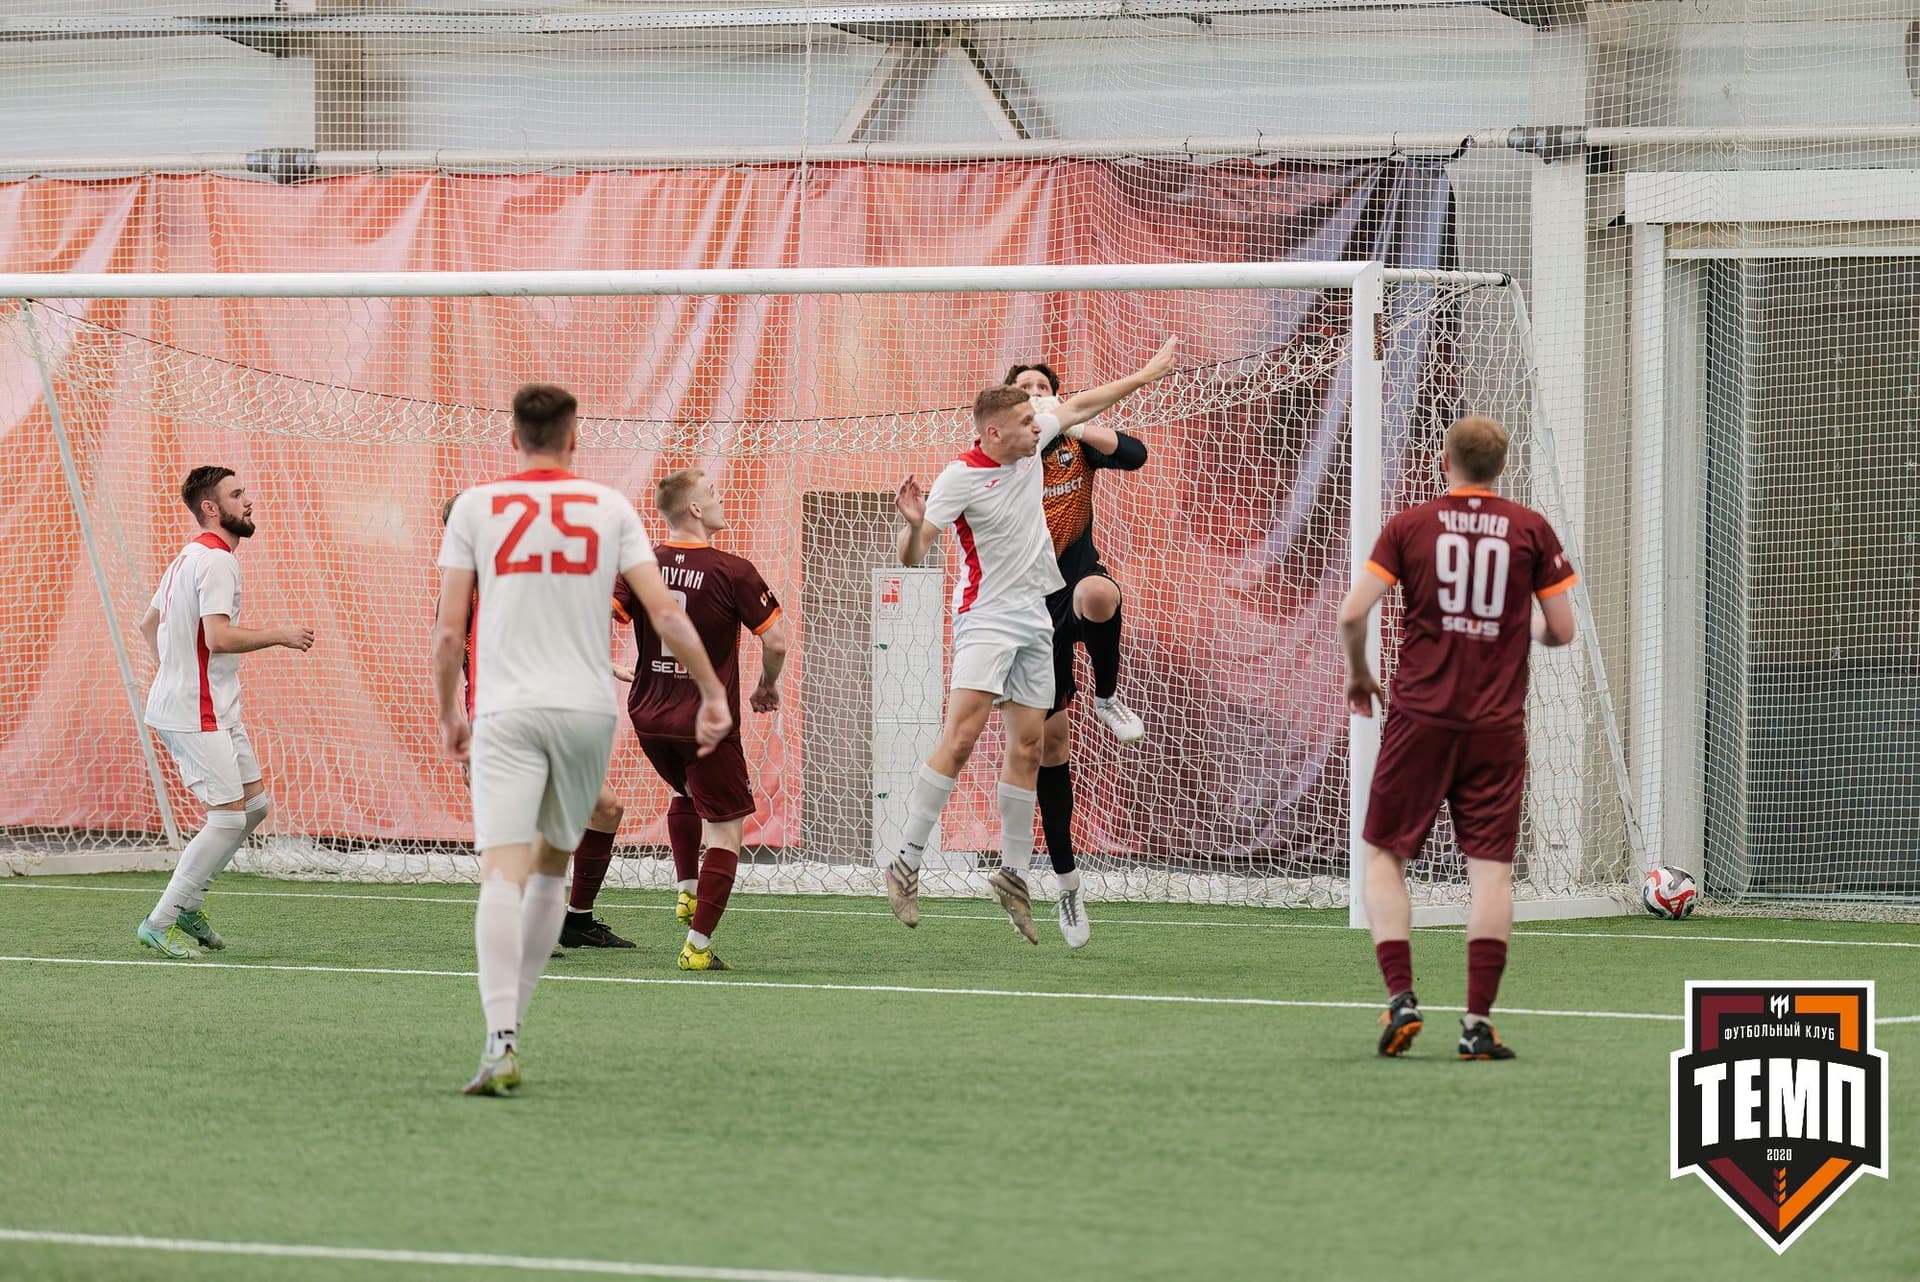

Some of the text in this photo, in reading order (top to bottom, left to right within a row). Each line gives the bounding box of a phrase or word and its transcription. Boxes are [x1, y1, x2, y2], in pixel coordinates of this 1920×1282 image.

[491, 493, 599, 577] 25
[1437, 510, 1510, 538] ЧЕВЕЛЕВ
[1435, 533, 1511, 619] 90
[1441, 615, 1500, 637] SEUS
[651, 660, 689, 674] SEU
